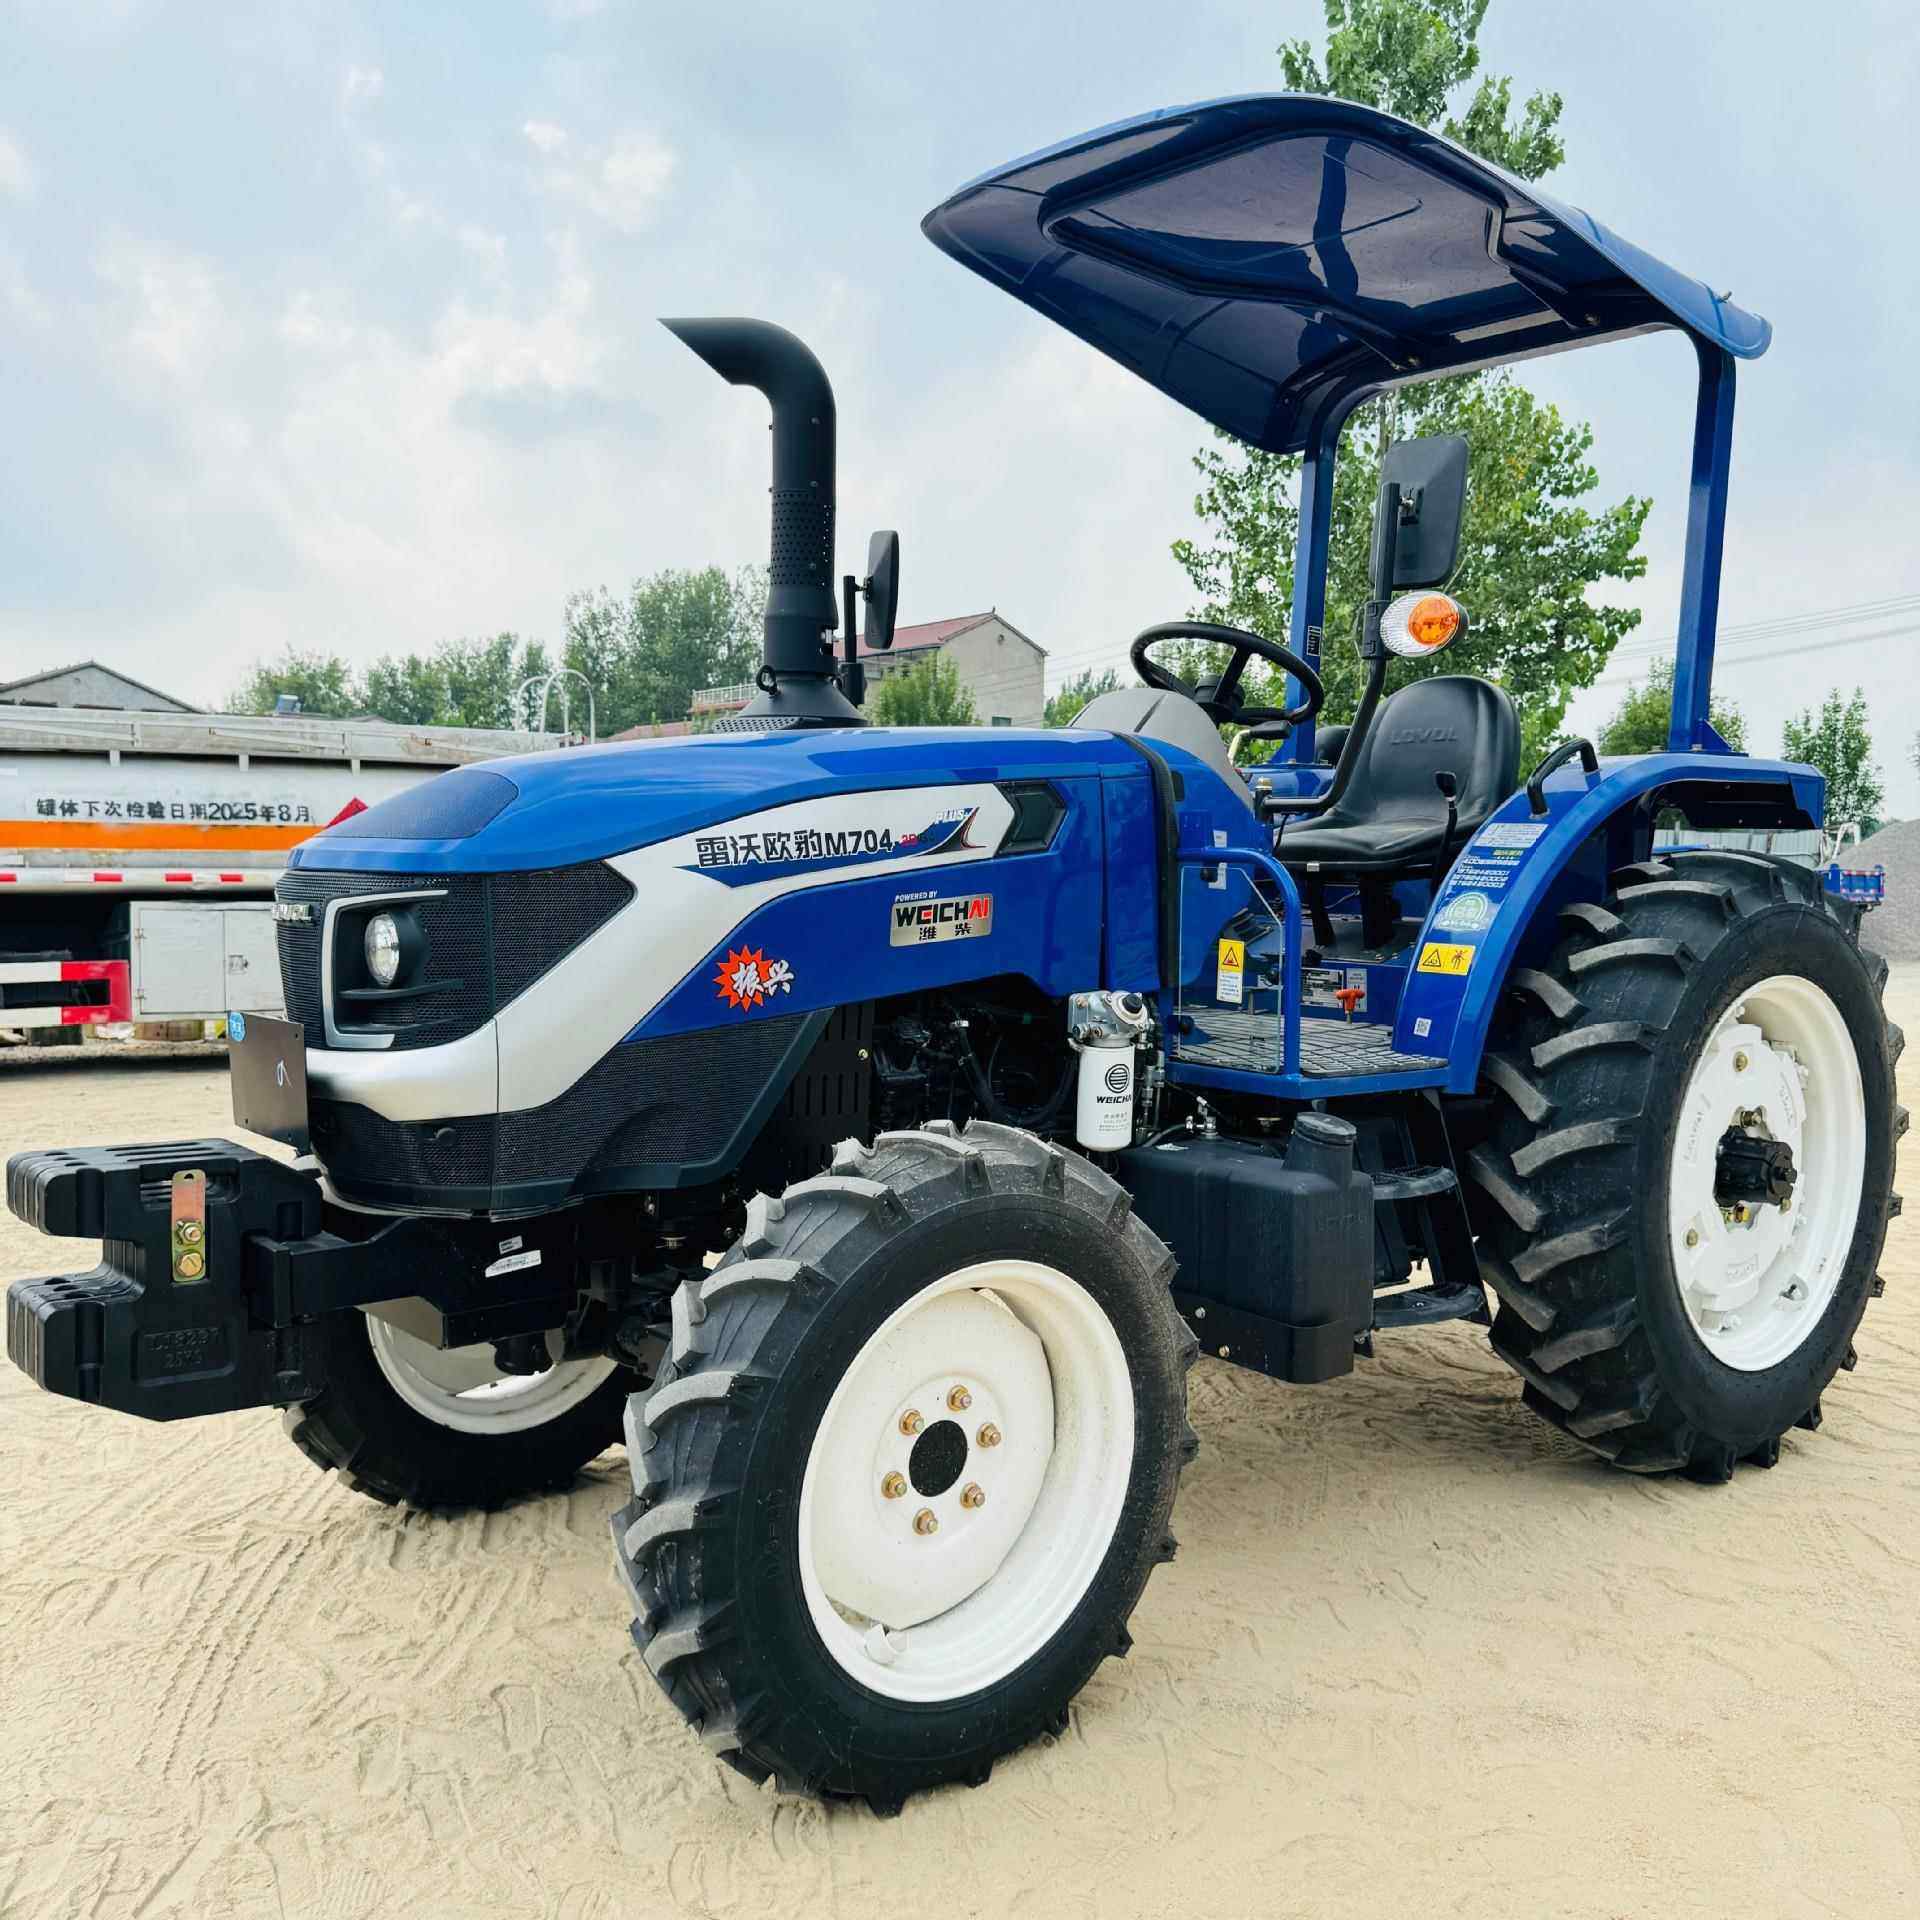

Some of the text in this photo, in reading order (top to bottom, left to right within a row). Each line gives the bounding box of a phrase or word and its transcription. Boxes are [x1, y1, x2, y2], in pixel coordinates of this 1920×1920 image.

[36, 798, 310, 823] 罐体下次检验日期2025年8月
[895, 889, 938, 903] POWERED BY
[895, 896, 989, 928] WEICHAI
